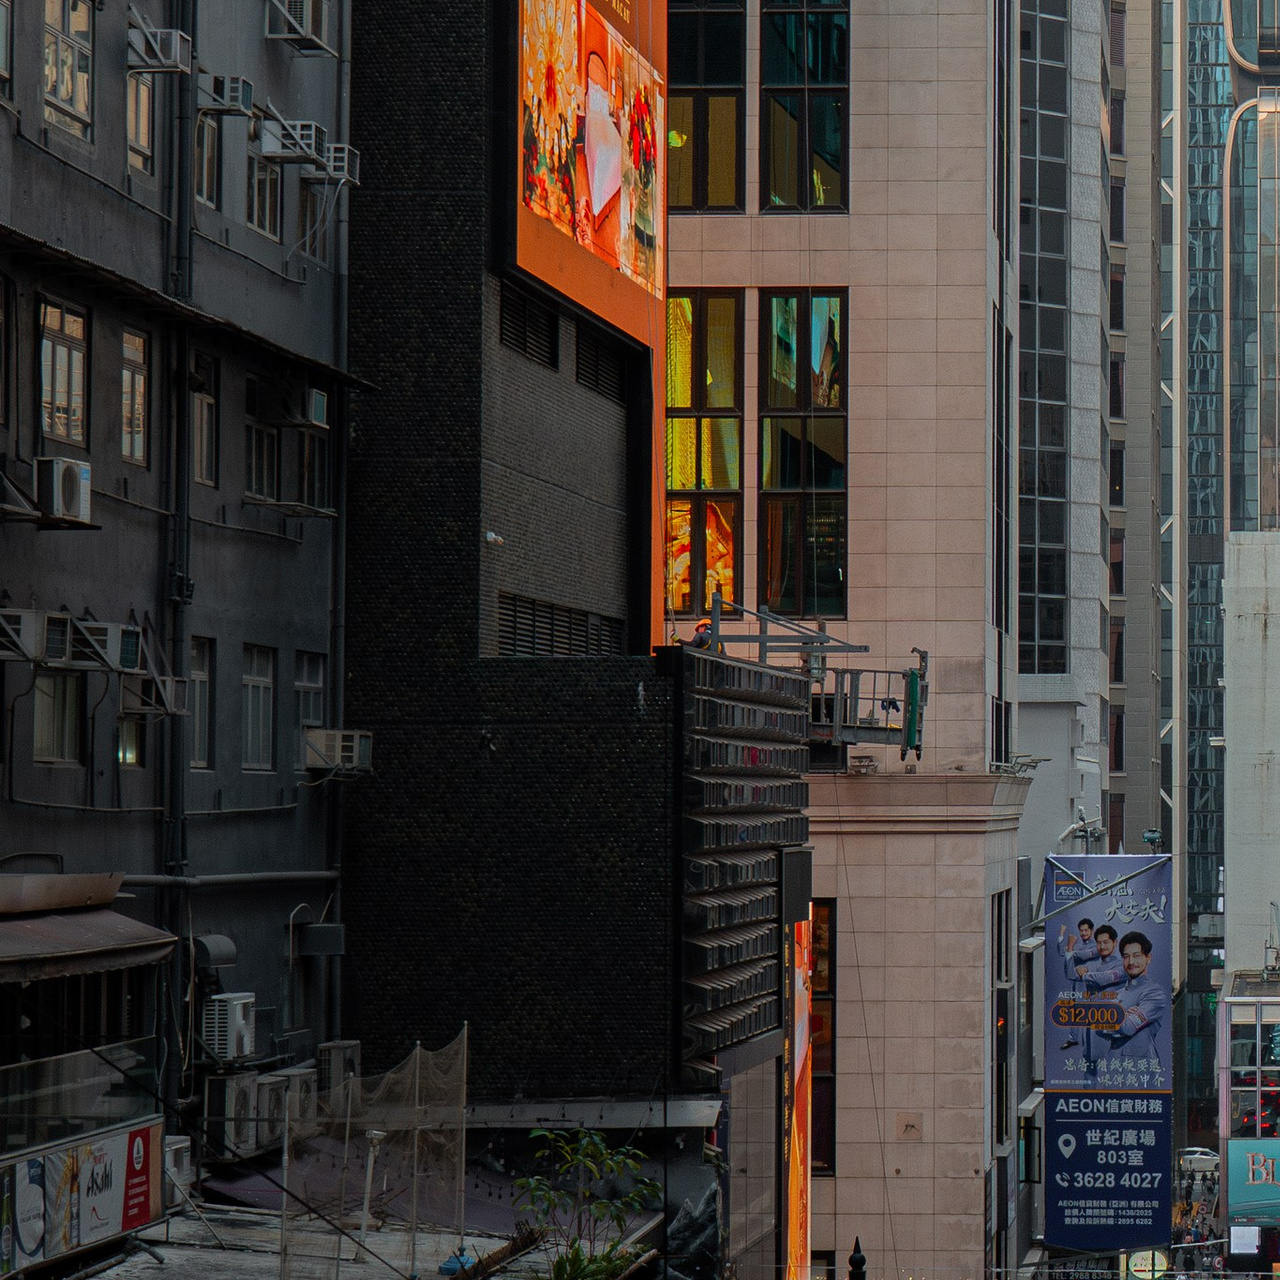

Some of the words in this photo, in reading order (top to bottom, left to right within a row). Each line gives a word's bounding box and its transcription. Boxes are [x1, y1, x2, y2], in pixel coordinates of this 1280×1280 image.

[1059, 1007, 1118, 1023] $12,000
[1055, 1099, 1162, 1113] AEON信貸財務
[1085, 1129, 1156, 1146] 世紀廣場
[1097, 1150, 1144, 1166] 803室
[1073, 1172, 1115, 1188] 3628
[1120, 1172, 1162, 1188] 4027
